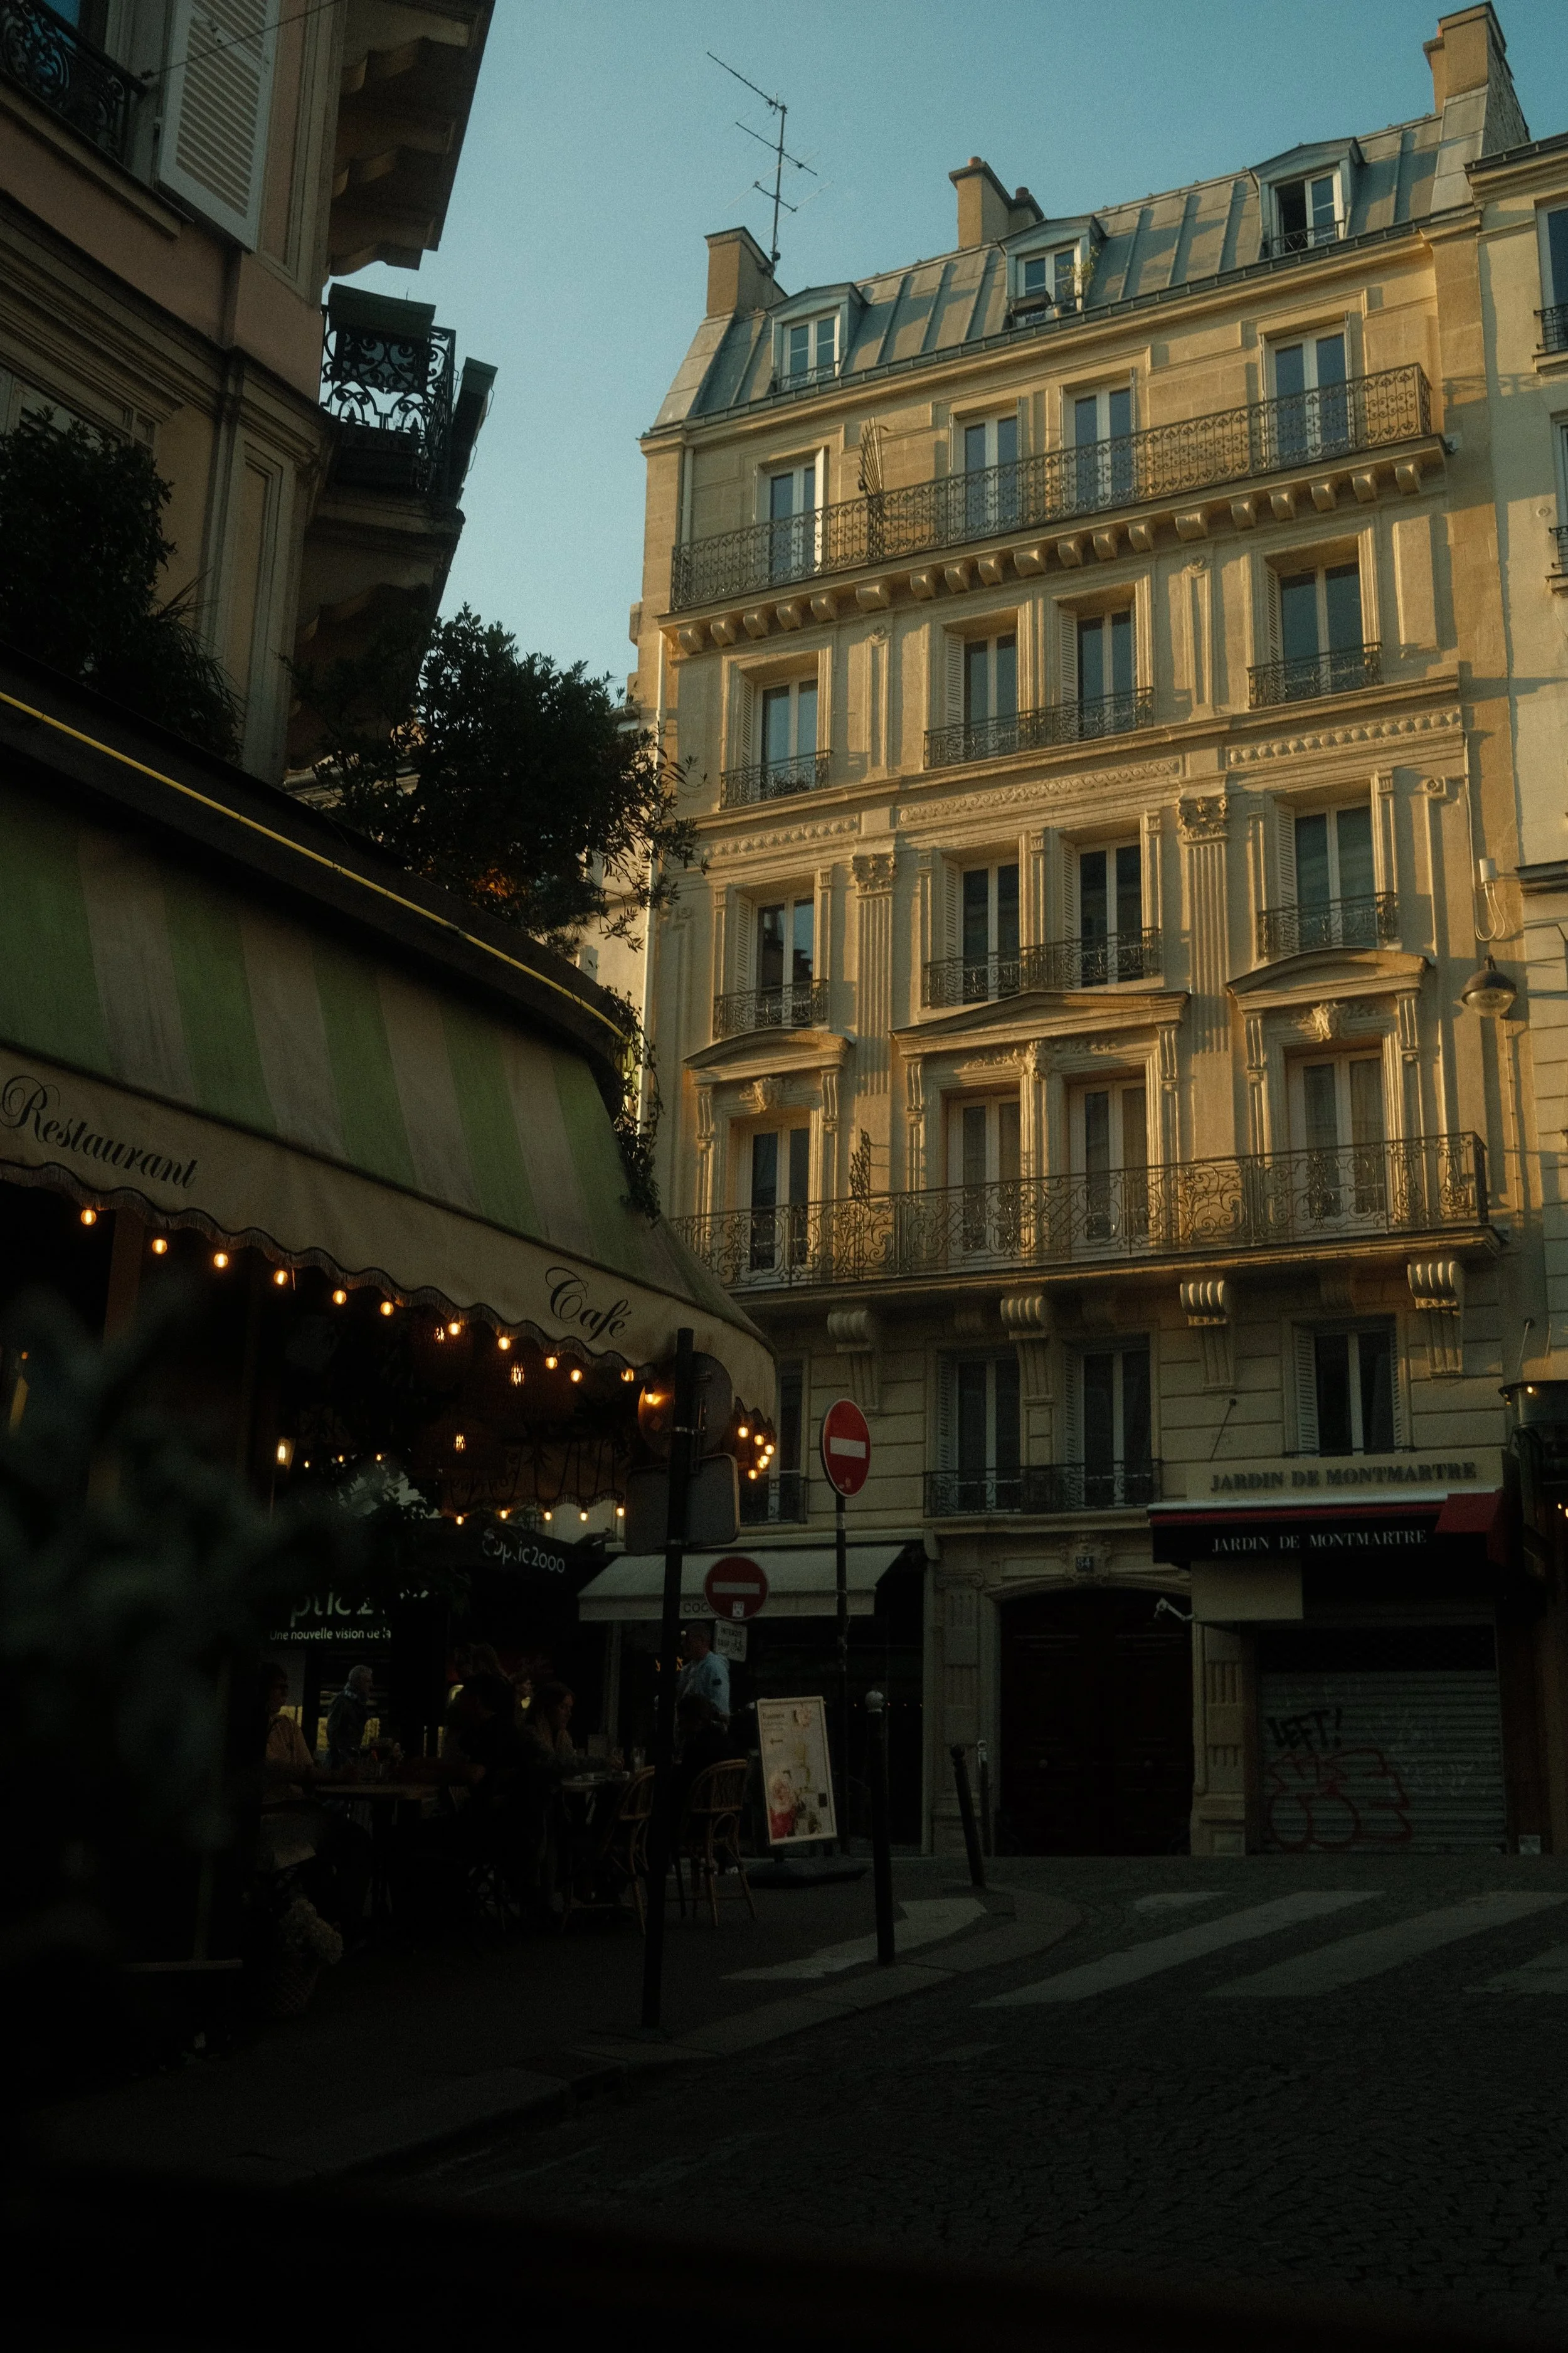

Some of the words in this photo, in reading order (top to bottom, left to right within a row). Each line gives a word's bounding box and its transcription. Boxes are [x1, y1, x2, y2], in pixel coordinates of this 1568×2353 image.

[0, 1075, 198, 1189] Restaurant
[545, 1267, 632, 1342] Café
[1210, 1470, 1285, 1492] JARDIN
[1291, 1469, 1320, 1487] DE
[1326, 1462, 1477, 1485] MONTMARTRE
[1211, 1537, 1270, 1553] JARDIN
[1279, 1534, 1300, 1549] DE
[1308, 1529, 1428, 1547] MONTMARTRE
[290, 1627, 333, 1640] nouvelle
[335, 1627, 365, 1639] vision
